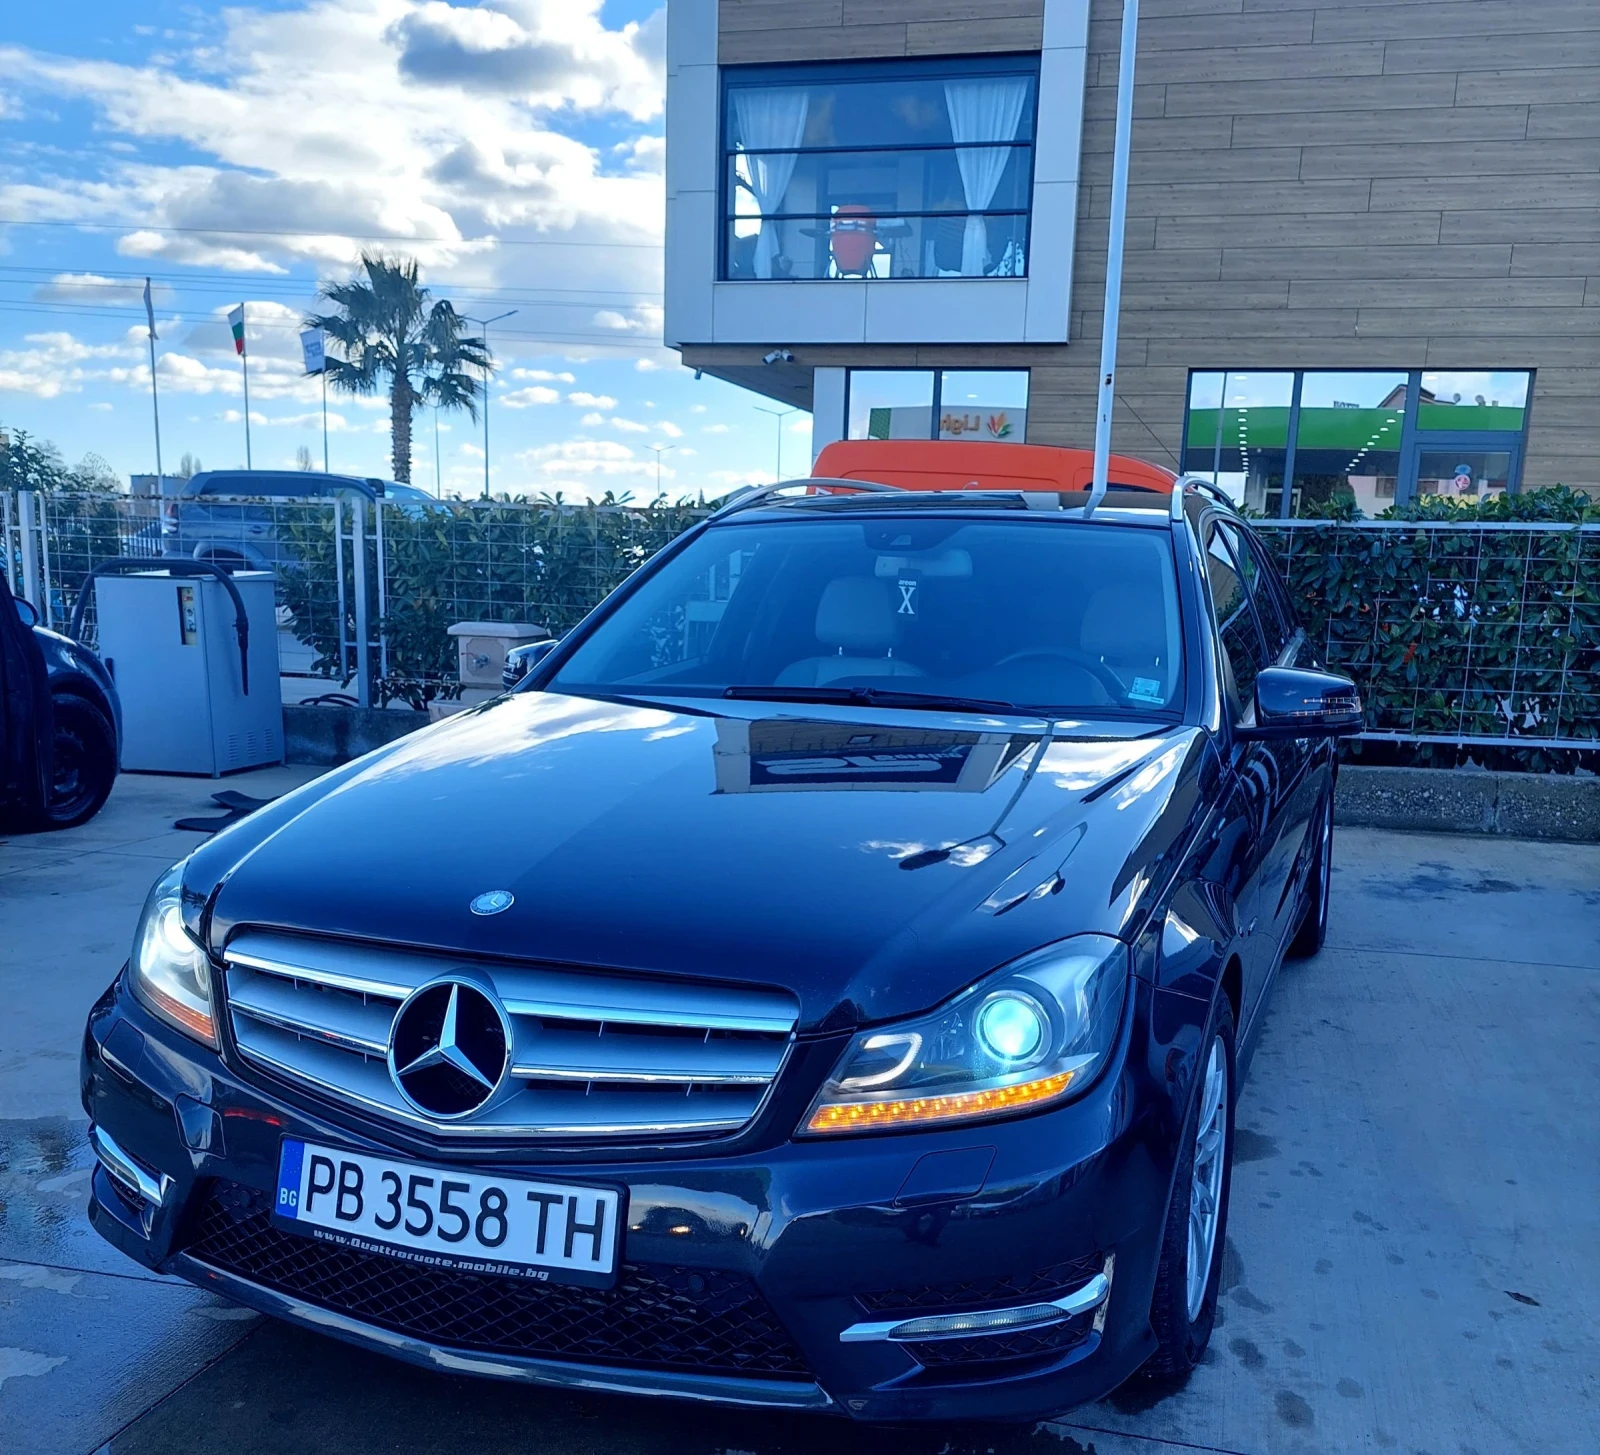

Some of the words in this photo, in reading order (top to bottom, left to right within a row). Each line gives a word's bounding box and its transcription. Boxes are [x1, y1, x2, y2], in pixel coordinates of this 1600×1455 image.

[897, 586, 917, 615] X
[280, 1187, 297, 1207] BG
[305, 1154, 364, 1222] PB
[374, 1170, 508, 1248] 3558
[526, 1190, 606, 1261] TH
[313, 1229, 550, 1281] www.Quattroruote.mobile.bg
